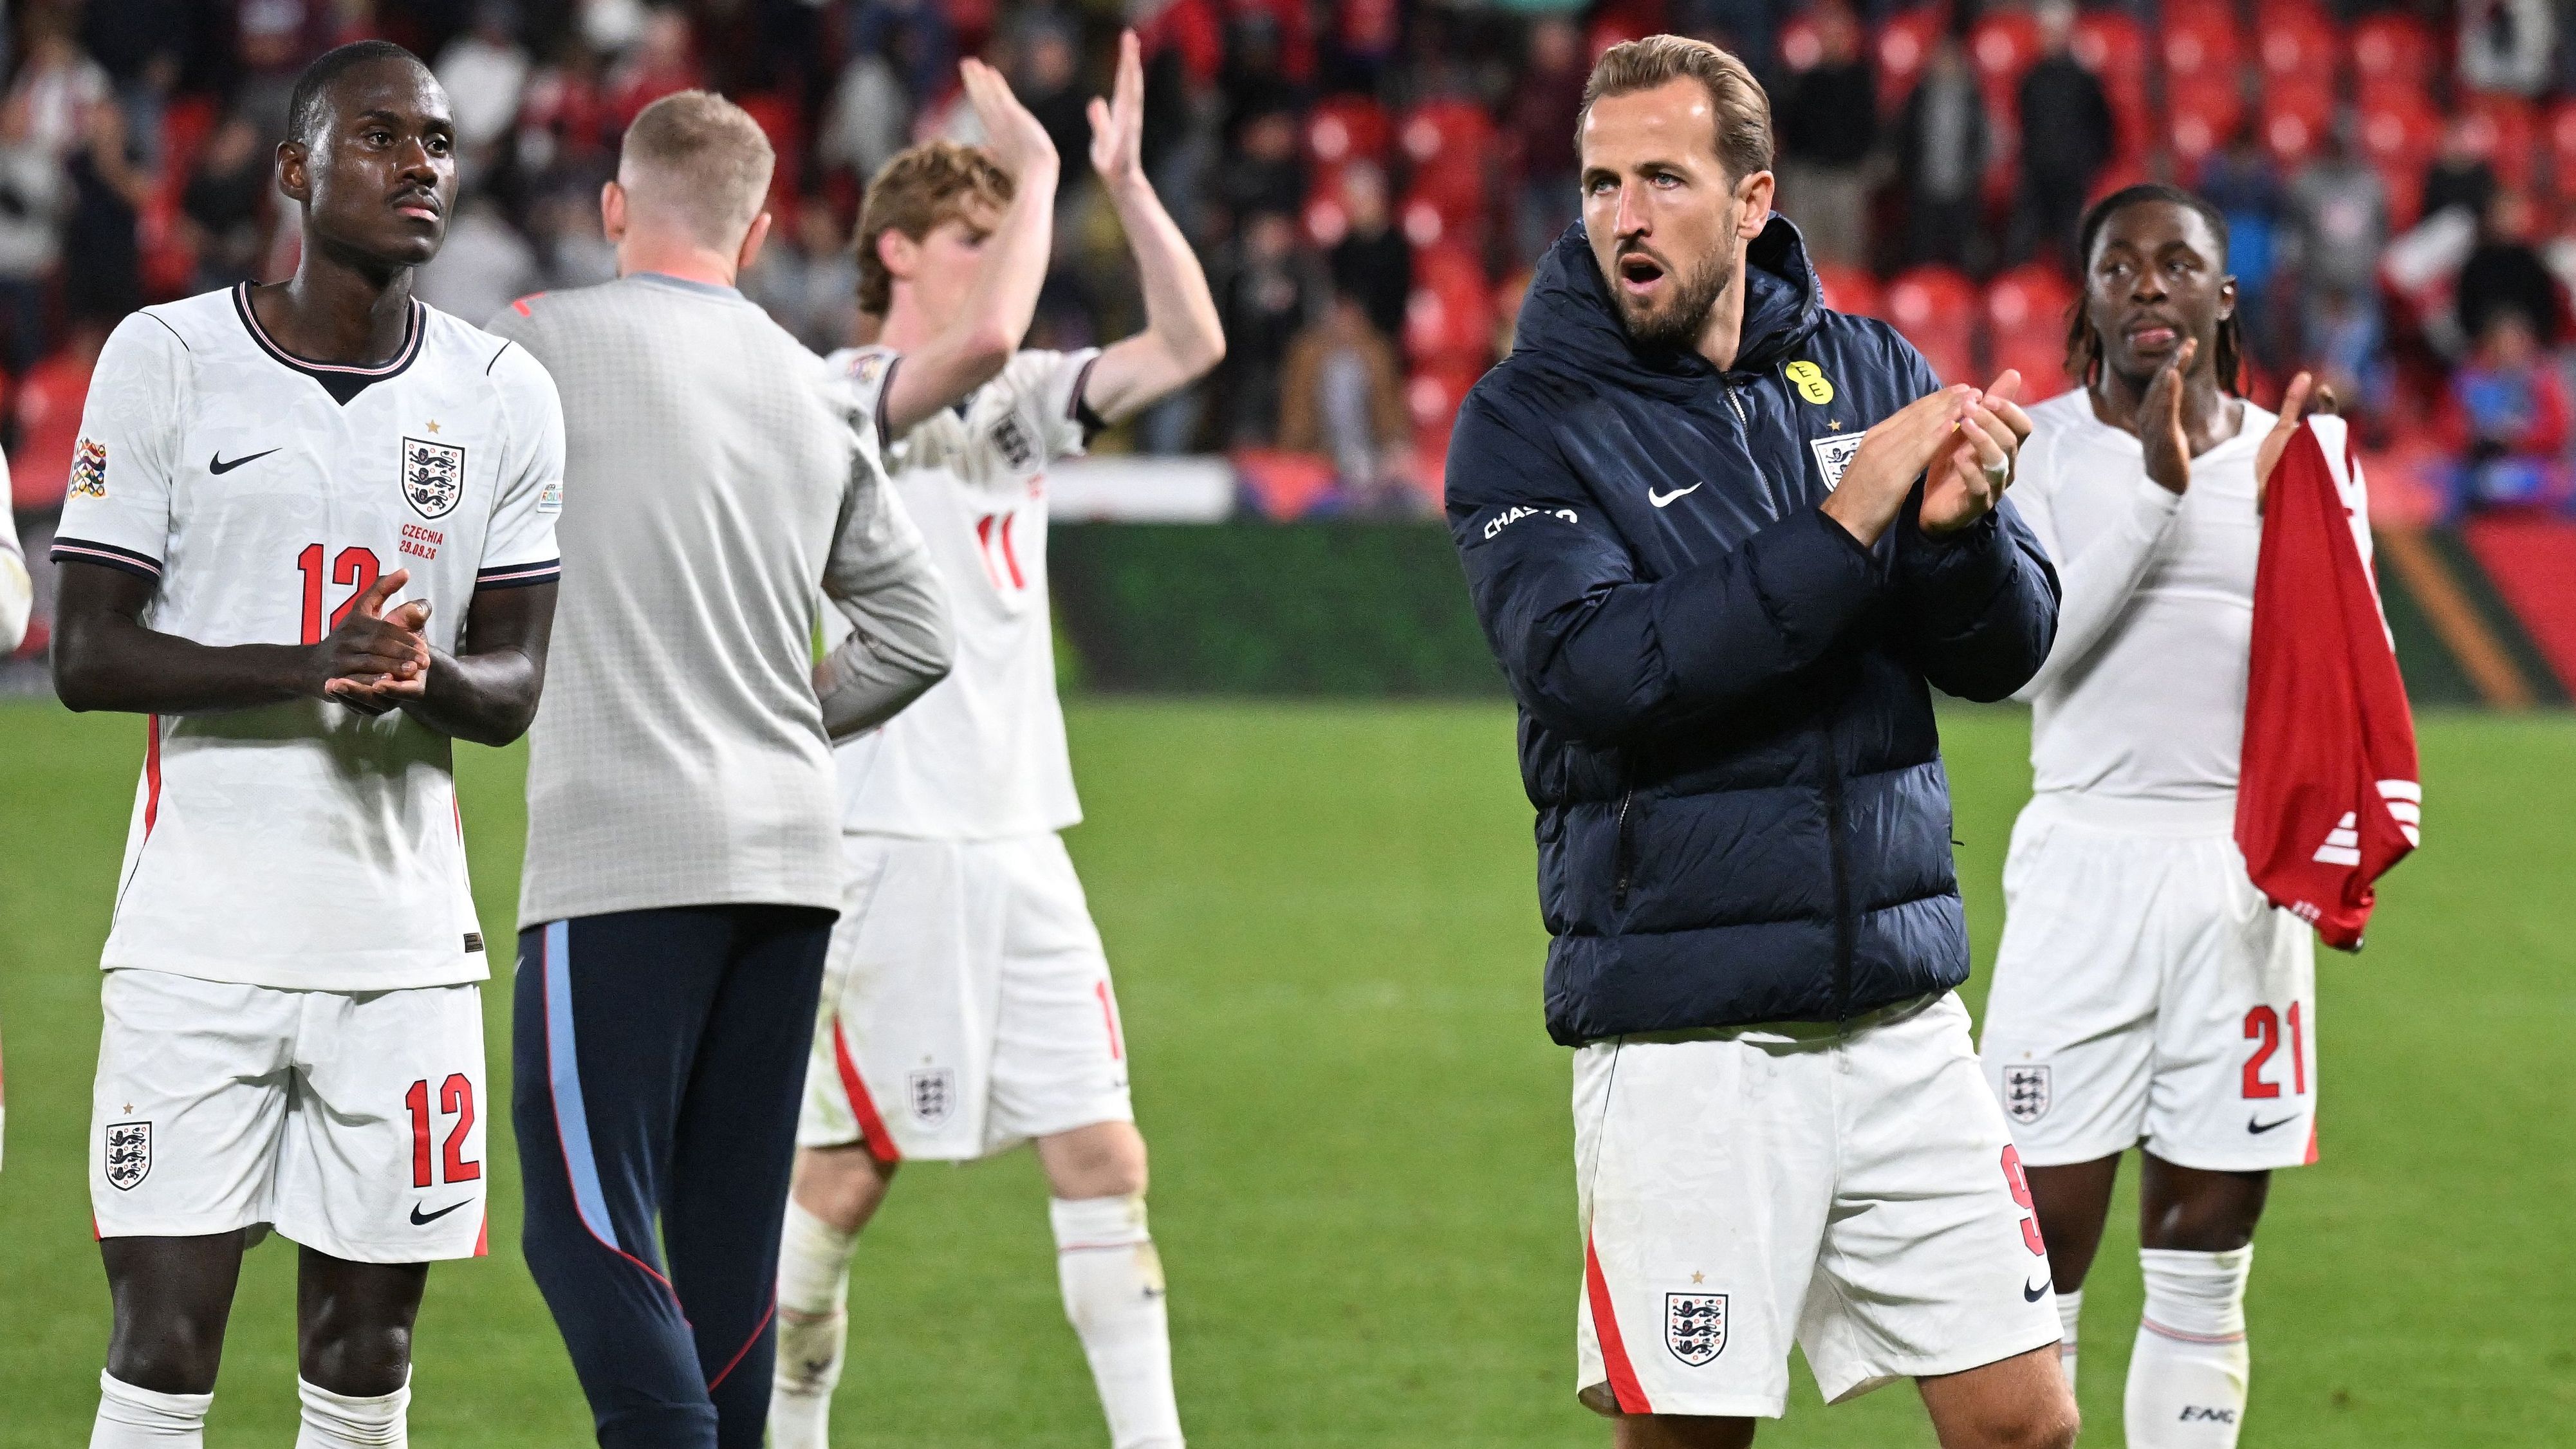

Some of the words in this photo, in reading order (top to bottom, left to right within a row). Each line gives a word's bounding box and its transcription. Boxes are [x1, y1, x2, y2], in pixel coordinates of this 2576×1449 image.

[399, 540, 436, 560] 29.09.26
[402, 524, 443, 546] CZECHIA
[297, 543, 380, 645] 12
[2243, 1001, 2304, 1098] 21
[405, 1073, 481, 1188] 12
[2001, 1143, 2045, 1257] 9
